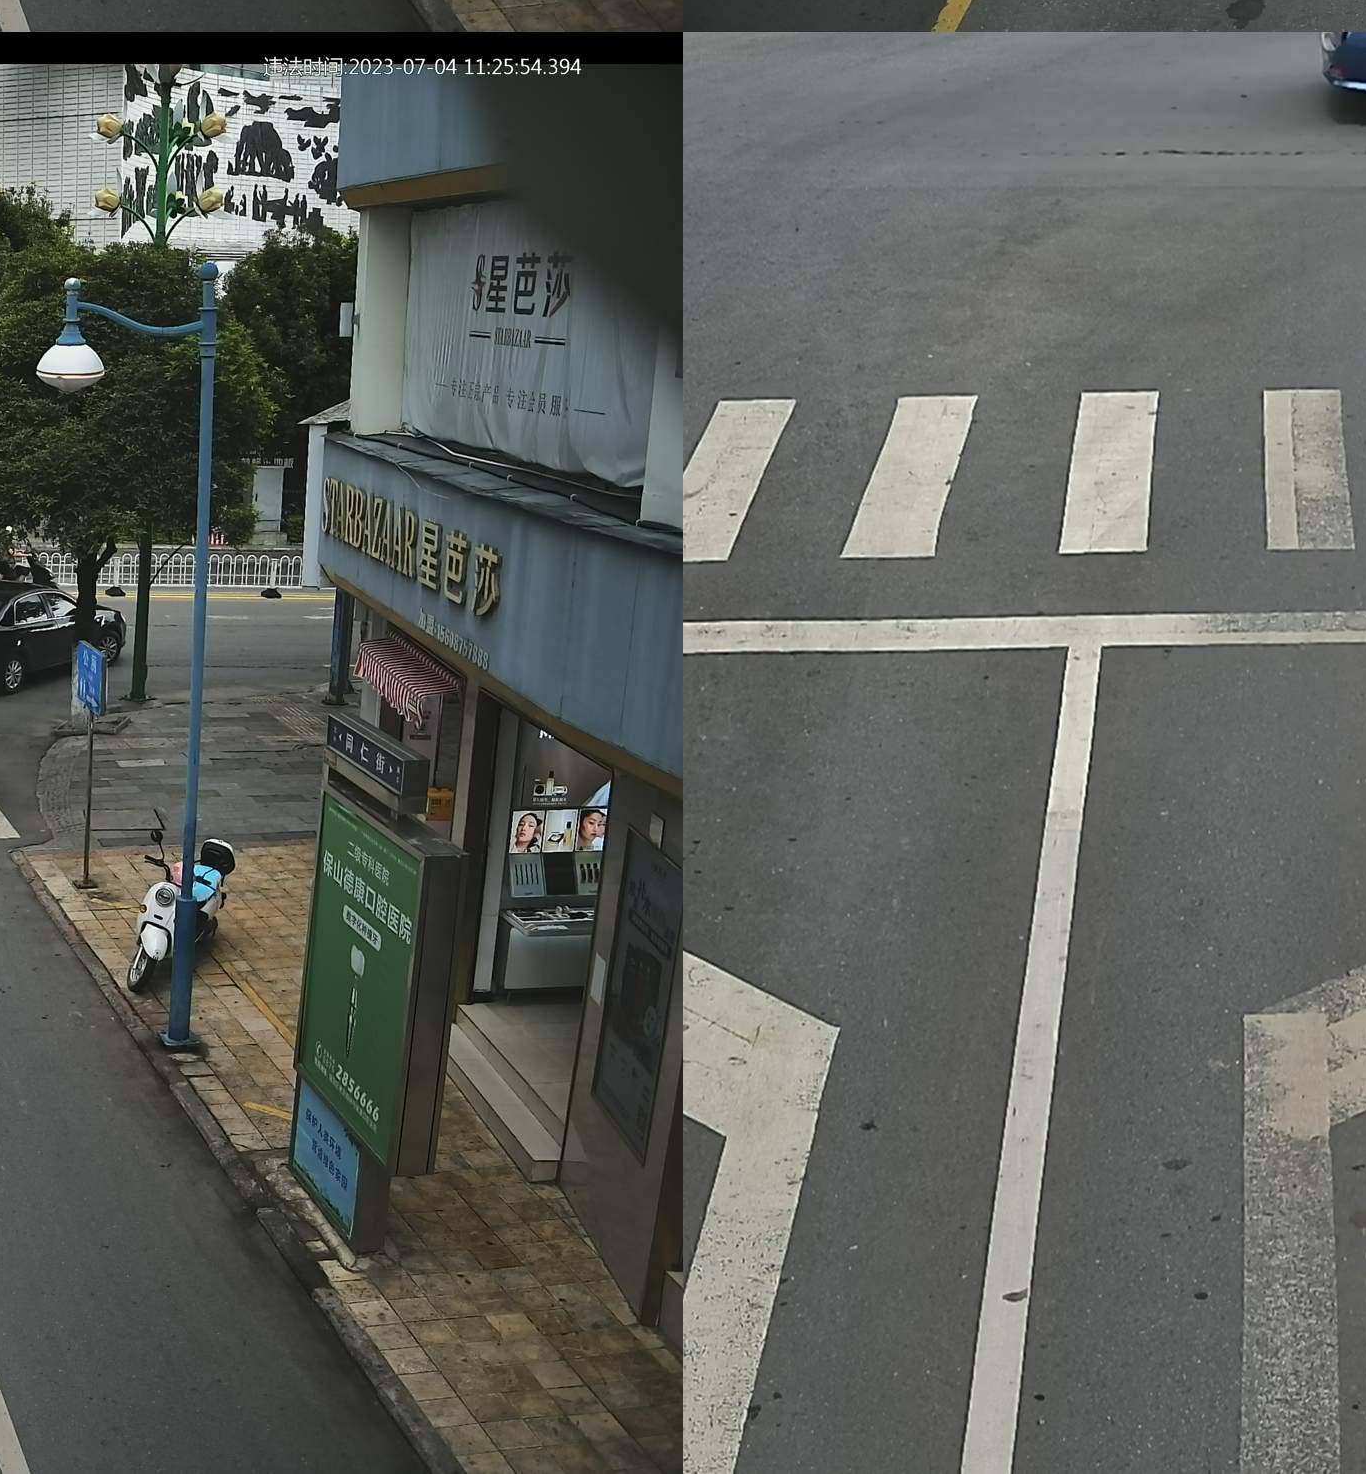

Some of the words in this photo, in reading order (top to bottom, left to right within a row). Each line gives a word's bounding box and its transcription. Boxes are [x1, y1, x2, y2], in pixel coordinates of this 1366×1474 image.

[485, 251, 574, 318] 星芭莎
[321, 477, 417, 579] STARBAZAAR
[418, 519, 501, 617] 星芭莎
[345, 732, 386, 775] 同仁街
[323, 850, 413, 945] 保山德康口腔医院
[335, 1064, 380, 1123] 2856666
